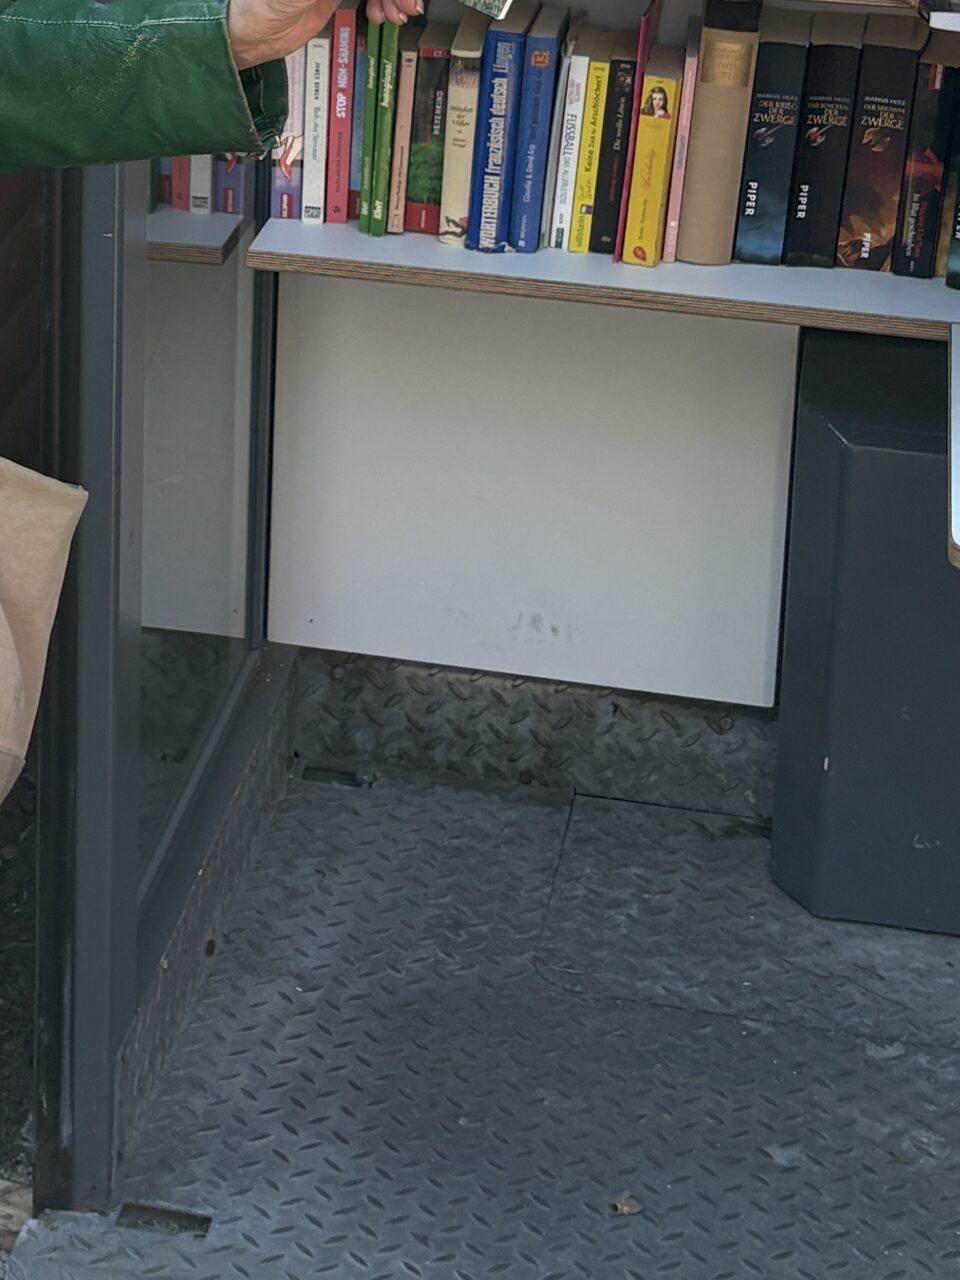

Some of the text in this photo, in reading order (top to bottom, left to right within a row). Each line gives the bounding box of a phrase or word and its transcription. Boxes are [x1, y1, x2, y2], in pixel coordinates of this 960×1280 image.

[336, 27, 349, 118] STOP MOM-SHAMING
[380, 59, 392, 107] buongiorno!
[433, 90, 443, 135] HEXENKIND
[585, 76, 603, 172] Keine Arschlöcher!
[753, 113, 795, 125] ZWERGE
[807, 115, 848, 127] ZWERGE
[861, 116, 904, 129] ZWERGE
[562, 114, 577, 156] FUSSBALL
[479, 78, 508, 248] WÖRTERBUCH französisch deutsch
[375, 200, 383, 220] Klett
[745, 182, 758, 215] PIPER
[796, 185, 809, 218] PIPER
[861, 233, 871, 258] PIPER
